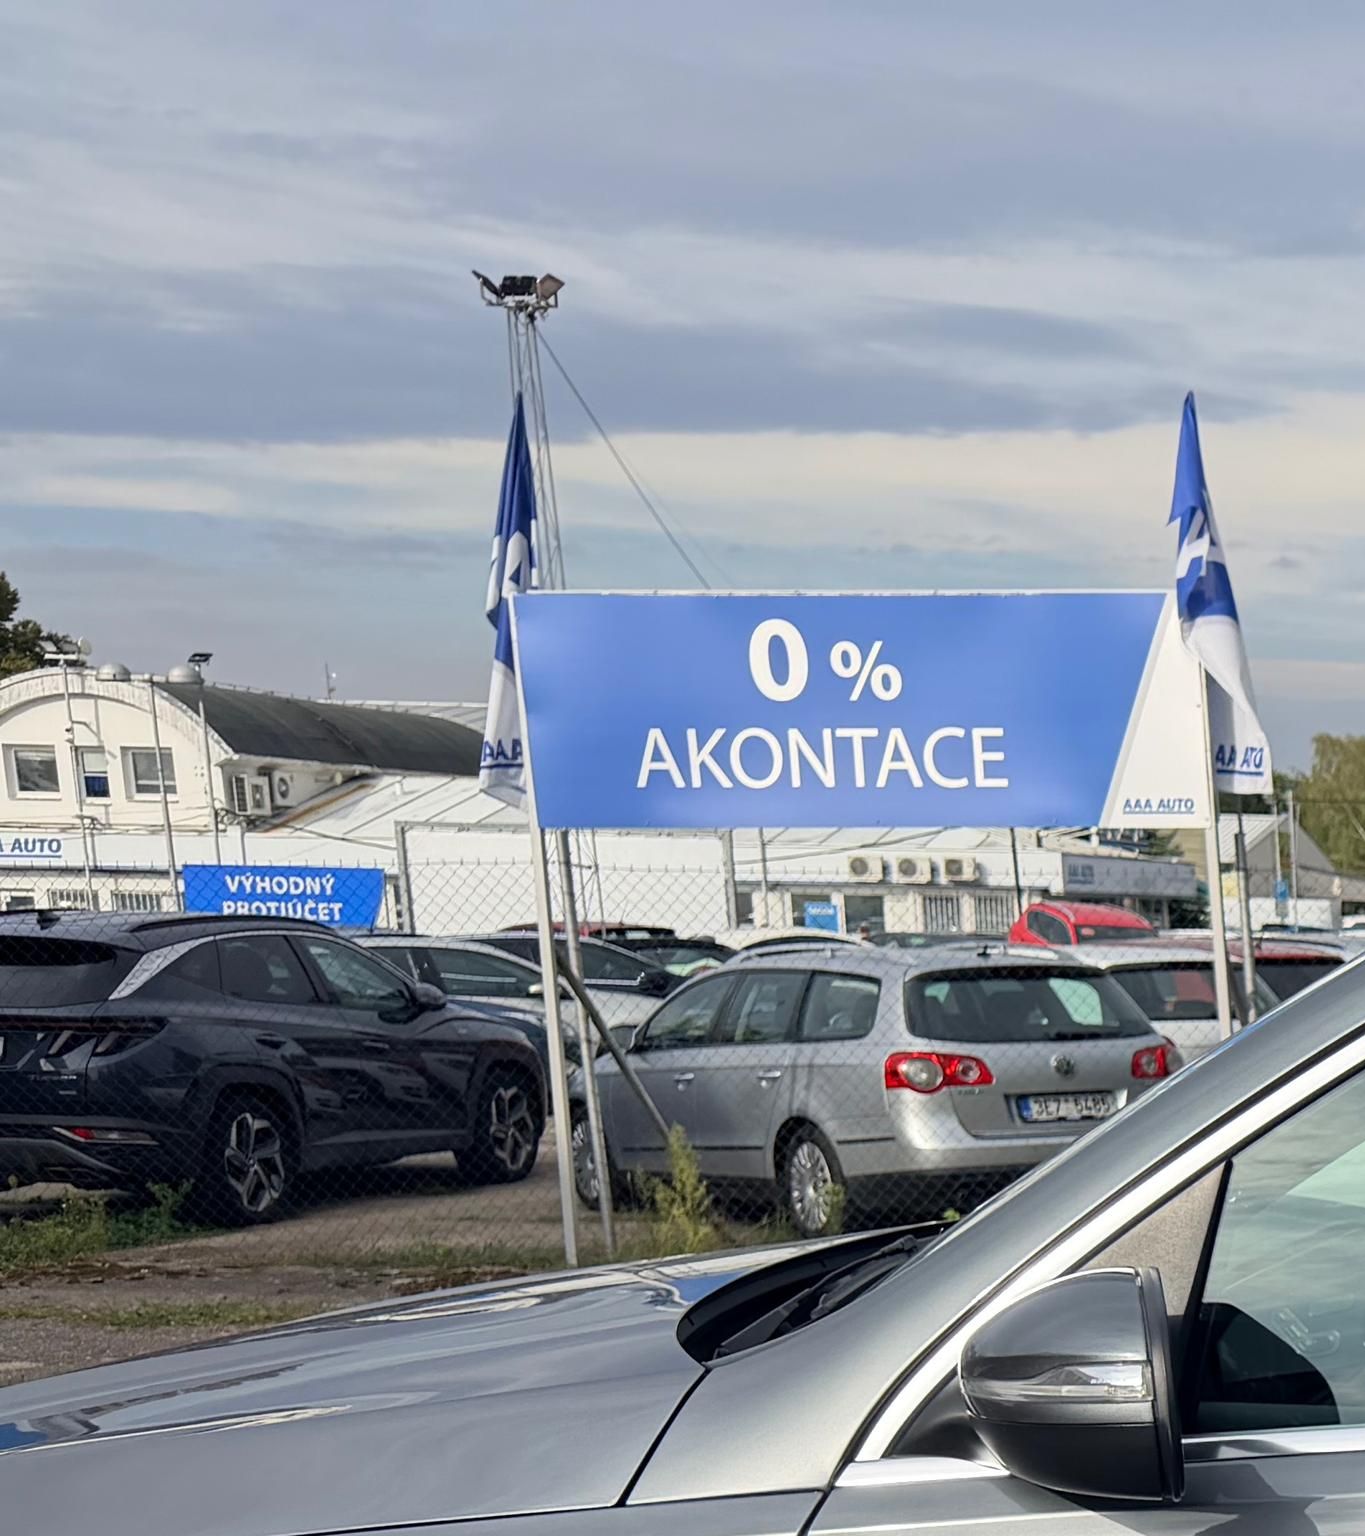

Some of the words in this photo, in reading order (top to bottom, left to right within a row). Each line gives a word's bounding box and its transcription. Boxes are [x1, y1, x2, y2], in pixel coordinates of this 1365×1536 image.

[749, 618, 809, 701] 0
[829, 640, 903, 701] %
[636, 727, 1009, 789] AKONTACE
[1123, 798, 1152, 811] AAA
[1157, 798, 1194, 811] AUTO
[10, 838, 62, 853] AUTO
[225, 872, 336, 896] VÝHODNÝ
[222, 899, 343, 921] PROTIÚČET
